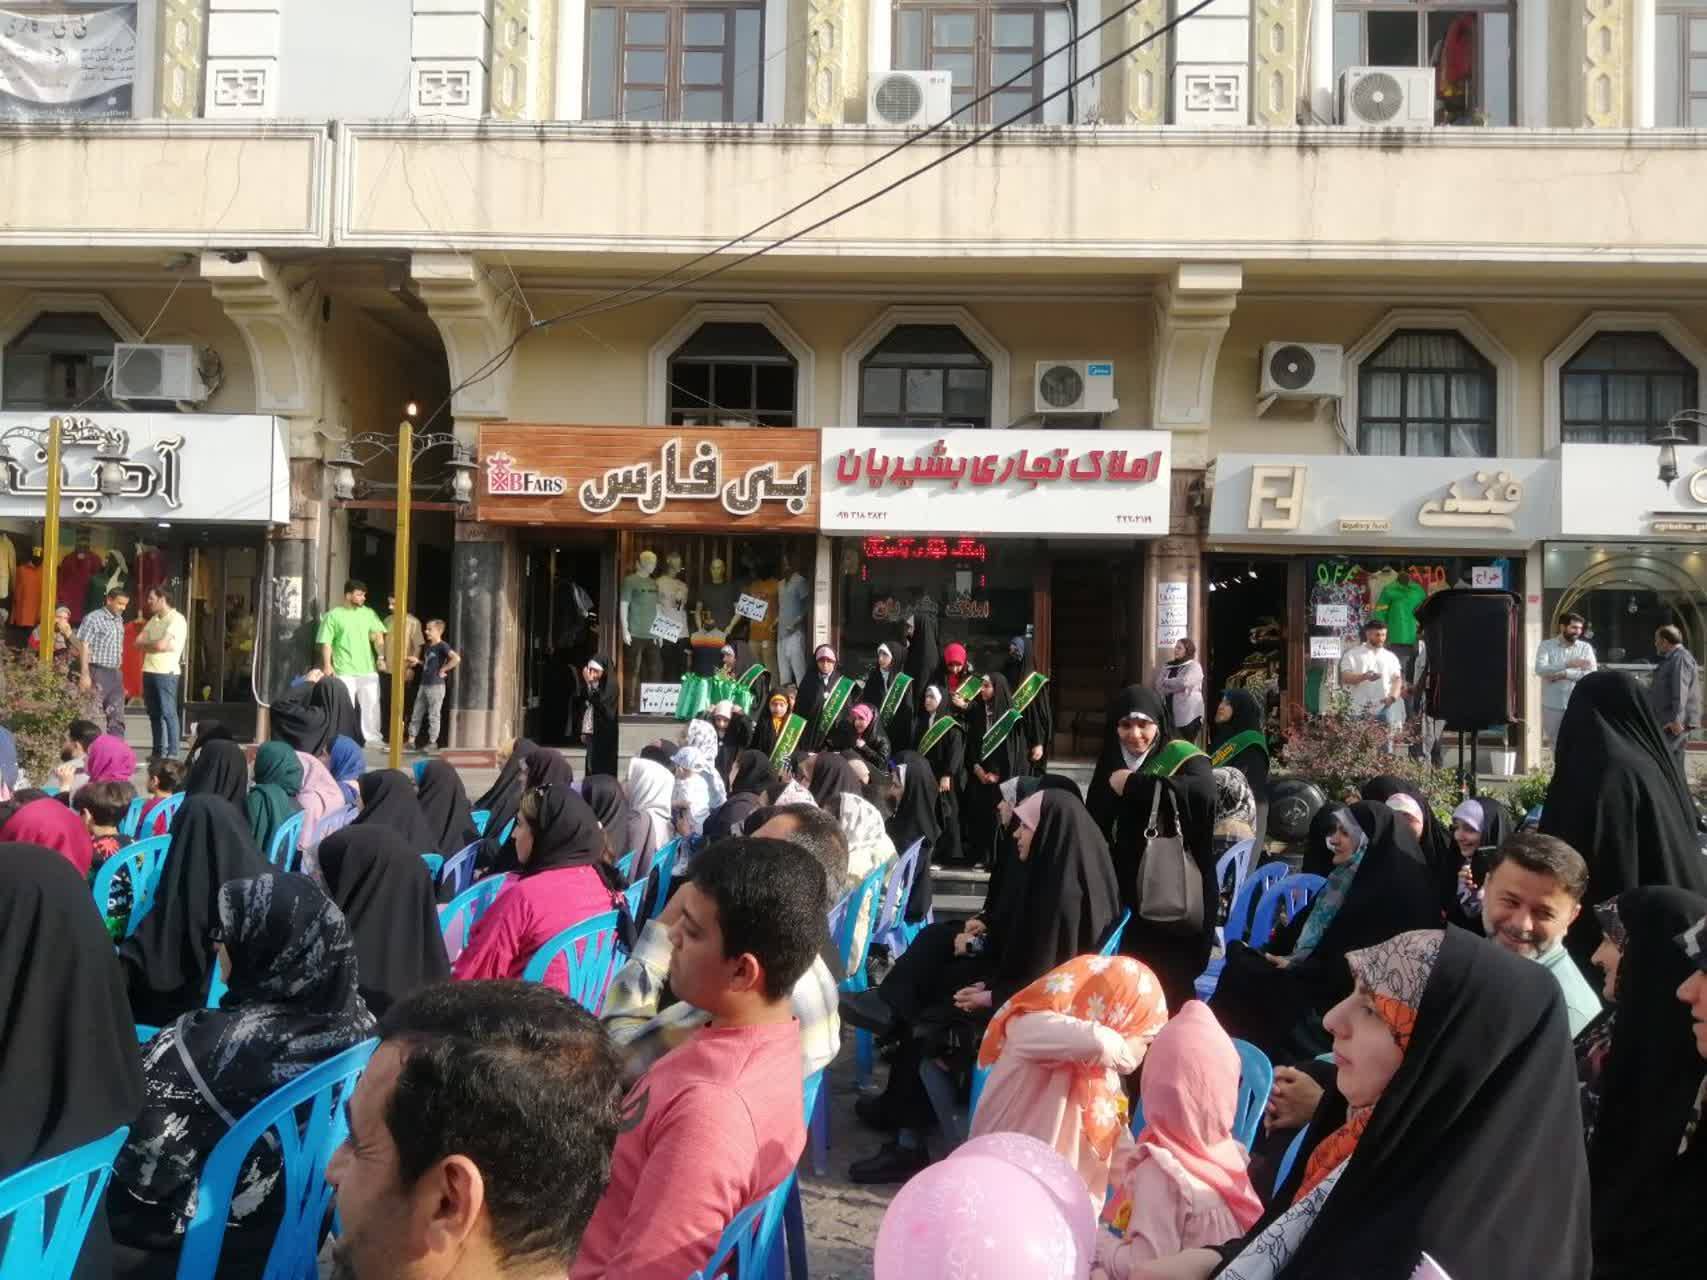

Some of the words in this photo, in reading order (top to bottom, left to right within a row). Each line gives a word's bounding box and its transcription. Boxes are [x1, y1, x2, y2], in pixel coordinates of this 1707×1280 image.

[579, 438, 720, 514] فارس
[836, 440, 968, 489] بشیریان
[969, 448, 1069, 488] تجاری
[1069, 449, 1162, 481] املاک
[723, 462, 812, 515] بی
[1474, 572, 1500, 585] حراج
